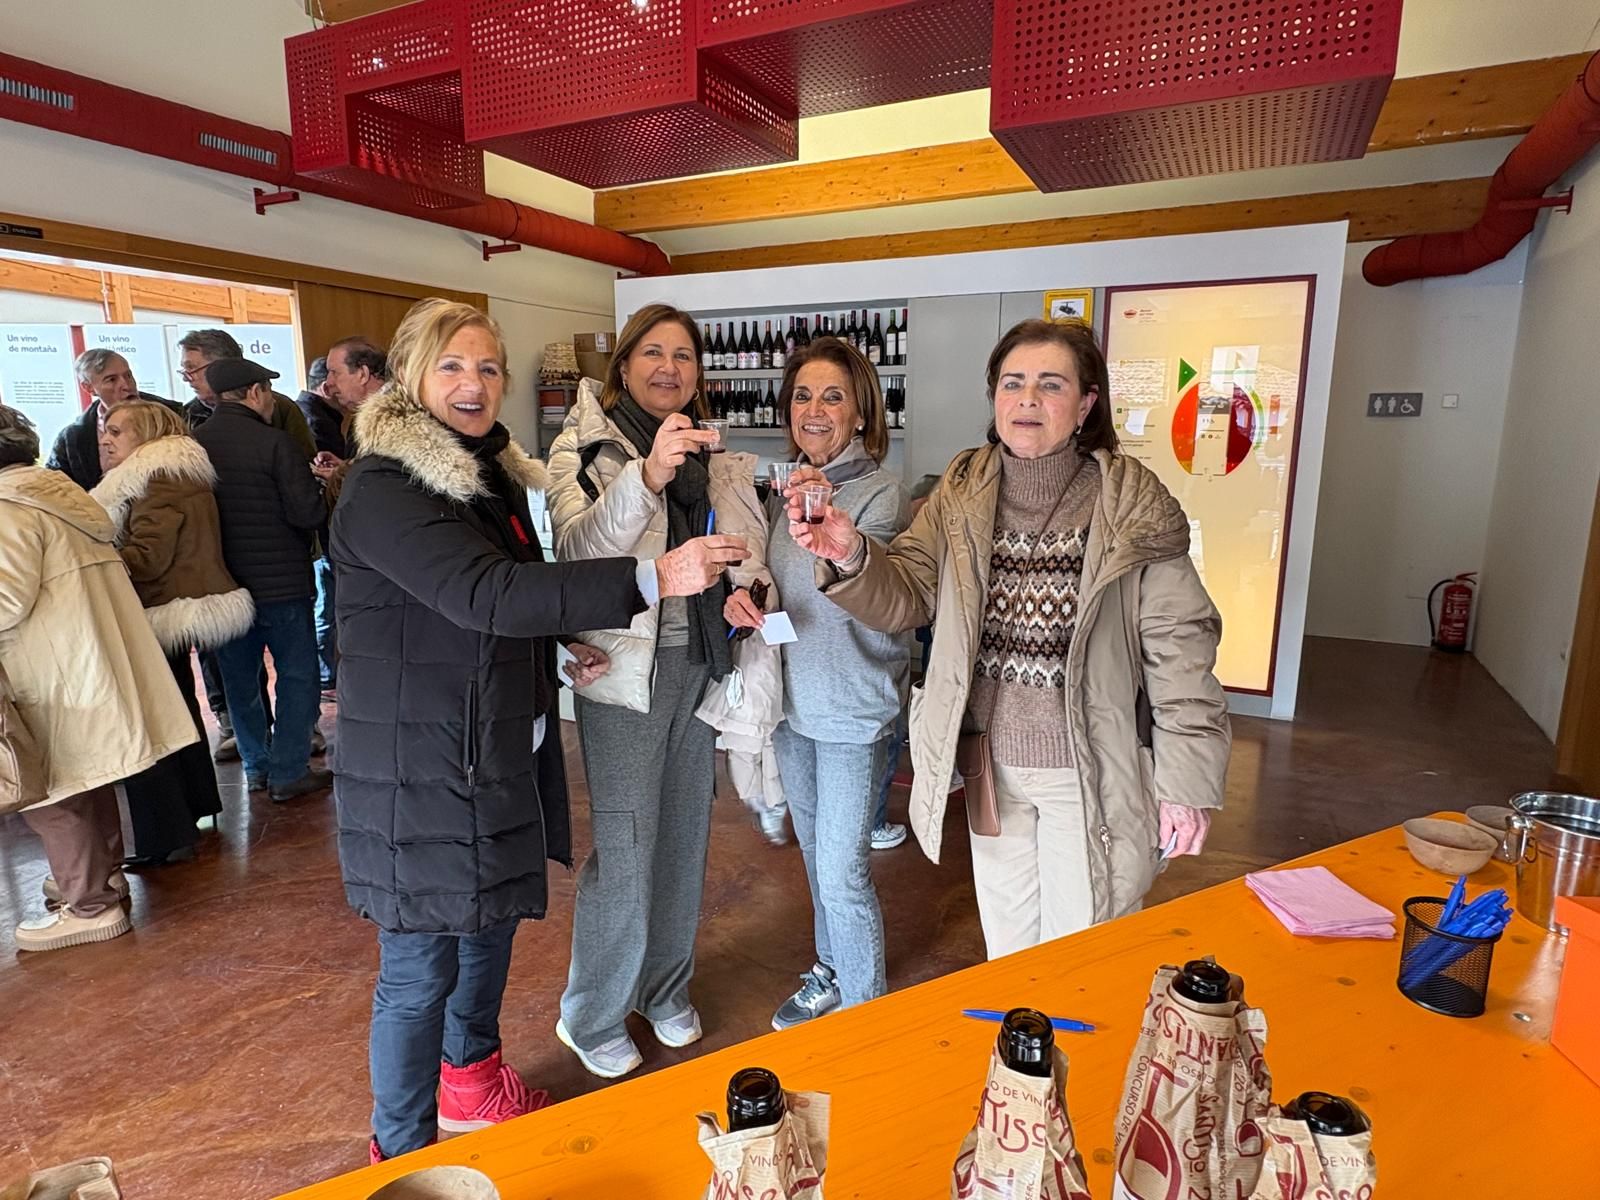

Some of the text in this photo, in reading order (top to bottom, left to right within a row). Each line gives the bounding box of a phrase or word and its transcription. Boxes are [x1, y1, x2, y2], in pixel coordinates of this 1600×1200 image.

[7, 334, 38, 342] Un vino
[98, 335, 130, 343] Un vino
[8, 345, 58, 353] de montaña
[250, 339, 271, 354] de
[1125, 1055, 1150, 1116] CONCURSO
[1003, 1086, 1019, 1099] DE
[1119, 1116, 1131, 1134] DE
